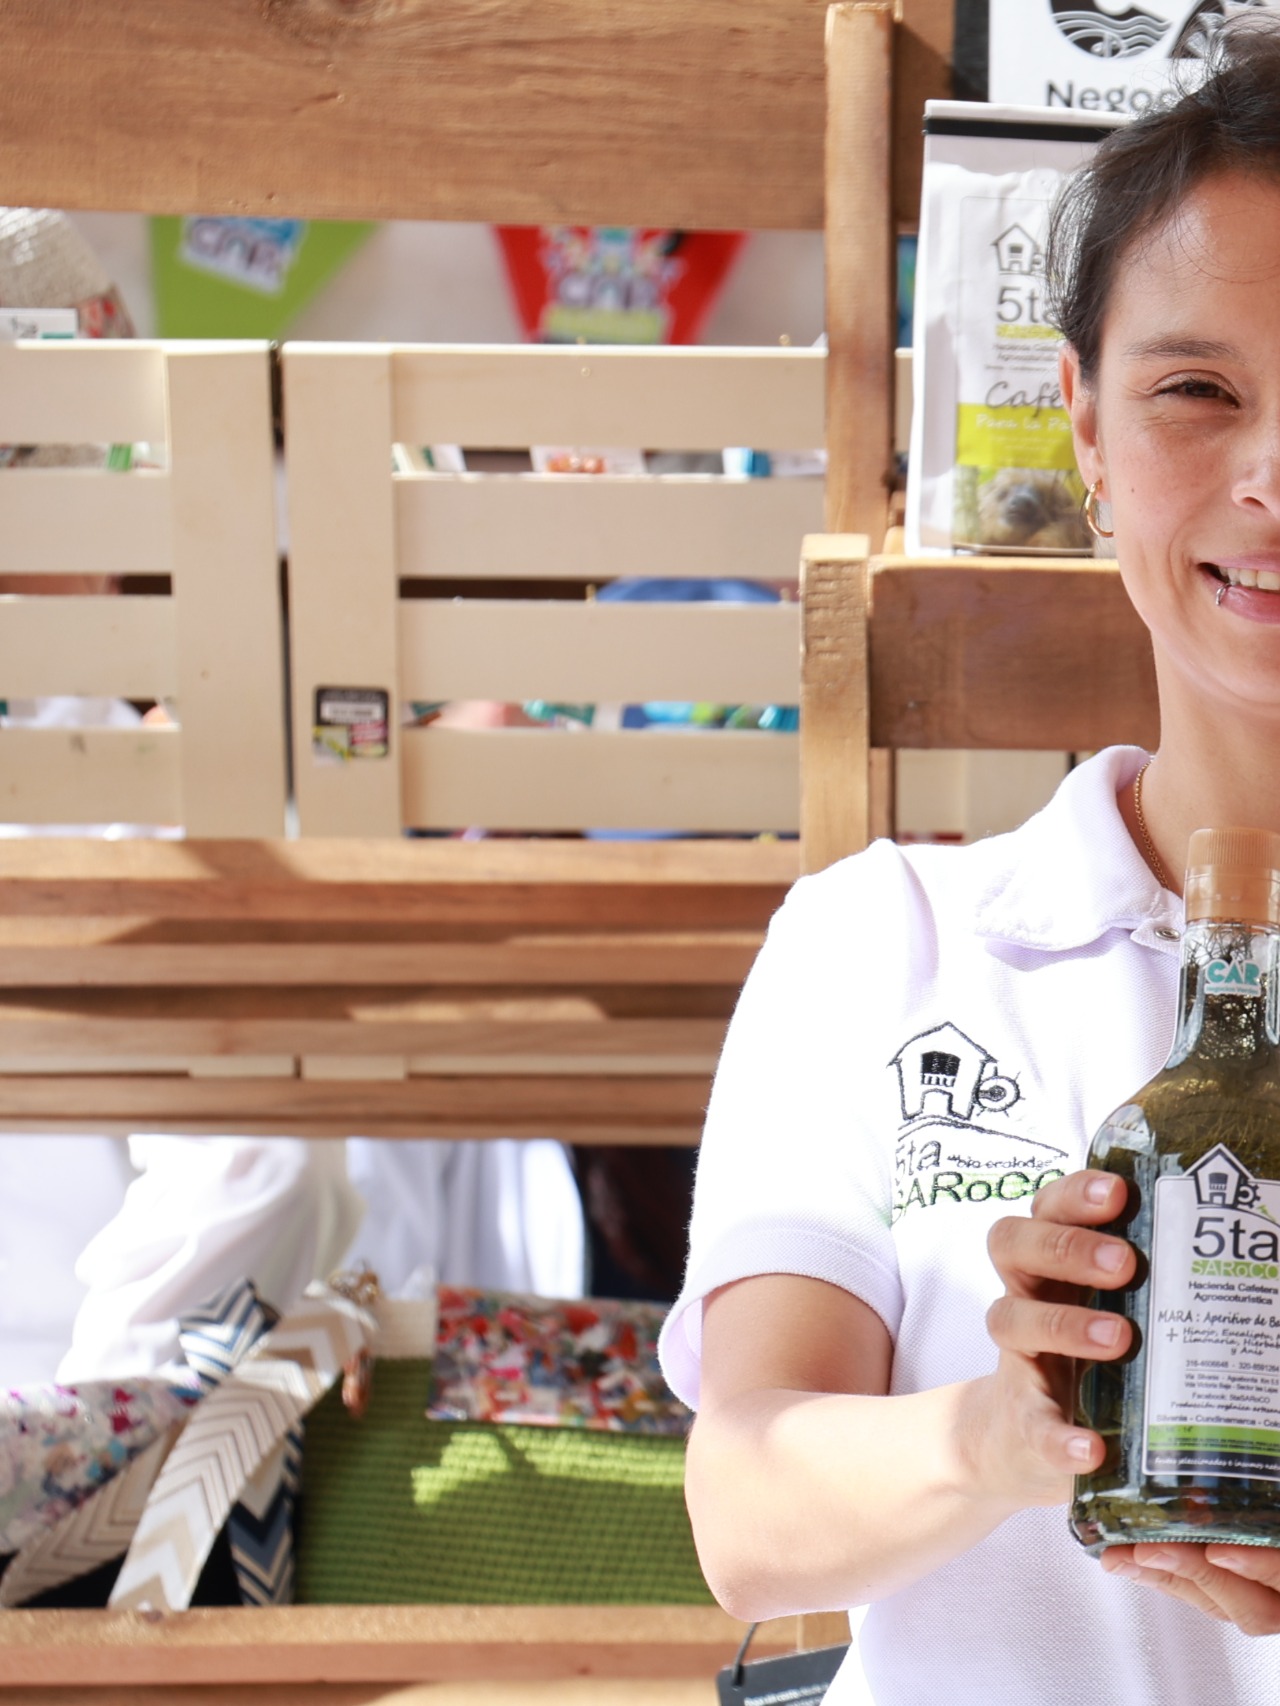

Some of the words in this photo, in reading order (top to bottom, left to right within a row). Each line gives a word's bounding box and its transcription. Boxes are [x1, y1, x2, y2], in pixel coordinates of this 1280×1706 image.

[1046, 79, 1184, 113] Negoc
[1048, 417, 1073, 432] Pa
[1207, 961, 1260, 986] CAR
[1192, 1216, 1279, 1263] 5ta
[1191, 1259, 1280, 1281] SARoCO
[1188, 1281, 1235, 1292] Hacienda
[1237, 1282, 1279, 1295] Cafetera
[1157, 1309, 1194, 1323] MARA
[1203, 1309, 1252, 1327] Aperitivo
[1254, 1314, 1266, 1327] de
